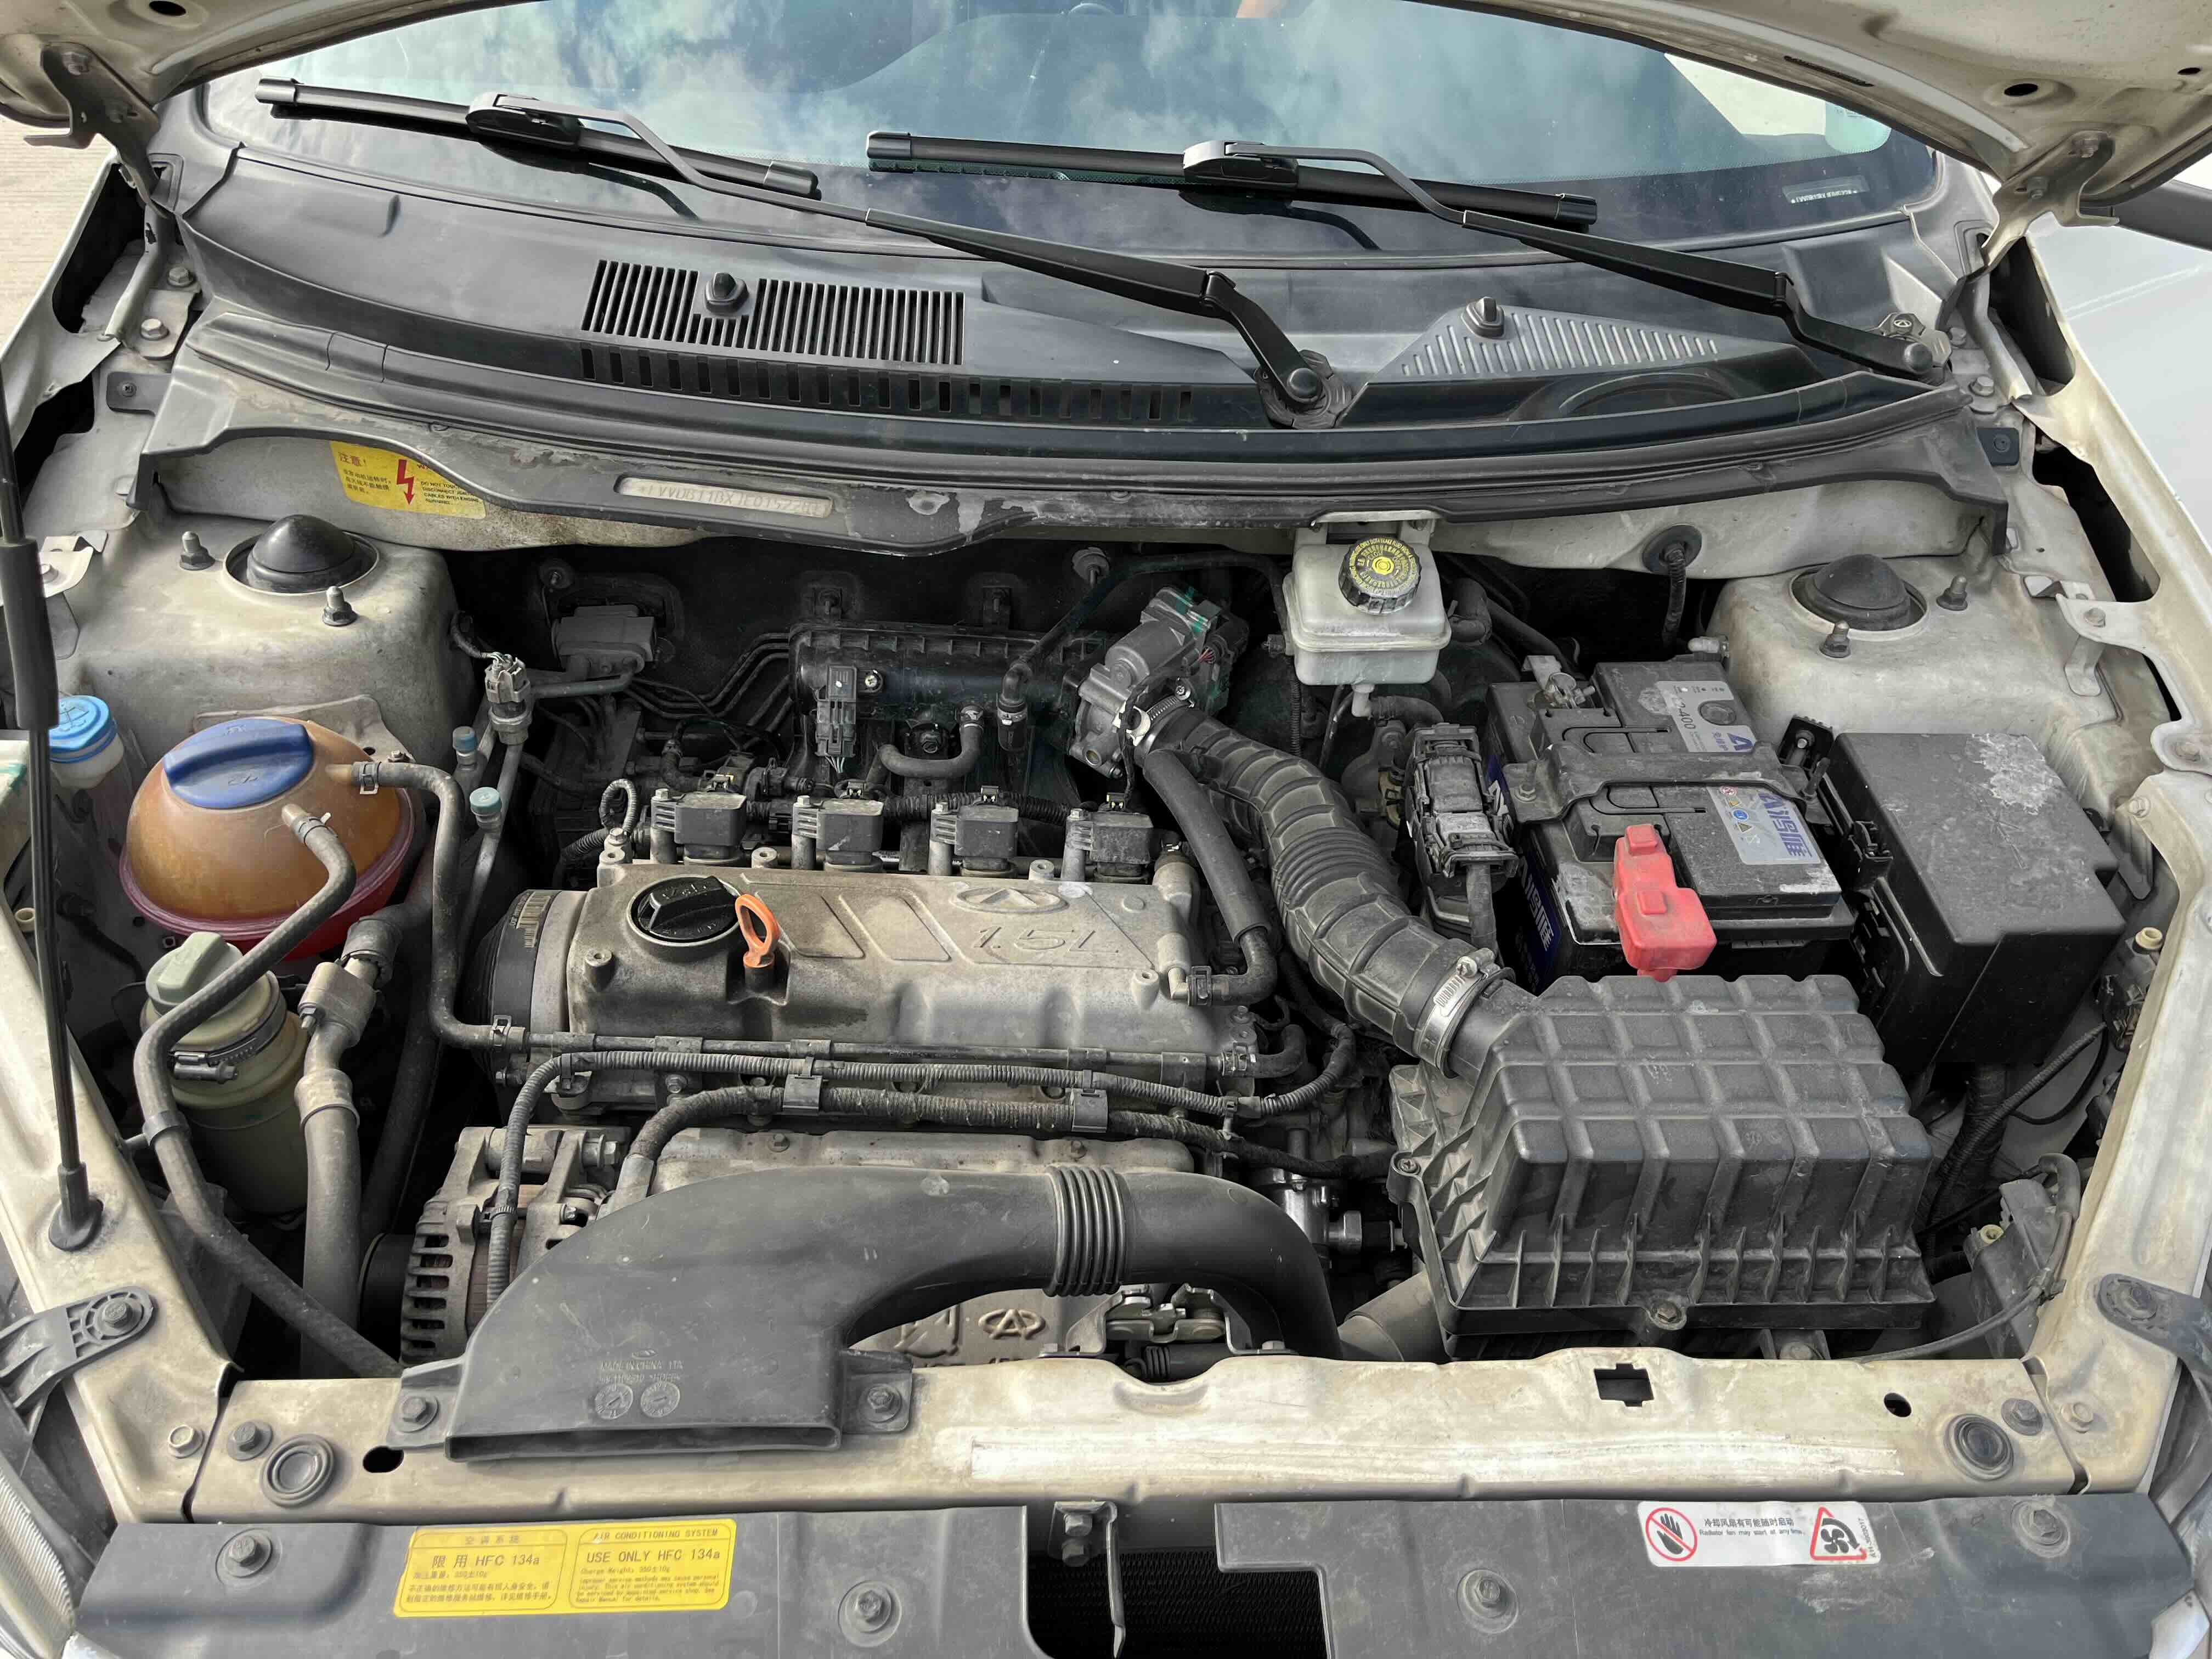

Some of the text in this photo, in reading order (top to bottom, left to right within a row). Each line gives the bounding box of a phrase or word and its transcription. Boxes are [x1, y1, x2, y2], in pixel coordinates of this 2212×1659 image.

[974, 927, 1120, 953] 1.5L
[615, 1531, 680, 1539] CONDITIONING
[685, 1529, 718, 1537] SYSTEM
[475, 1554, 505, 1566] HFC
[512, 1554, 540, 1566] 134a
[587, 1549, 720, 1562] USE ONLY HFC 134a
